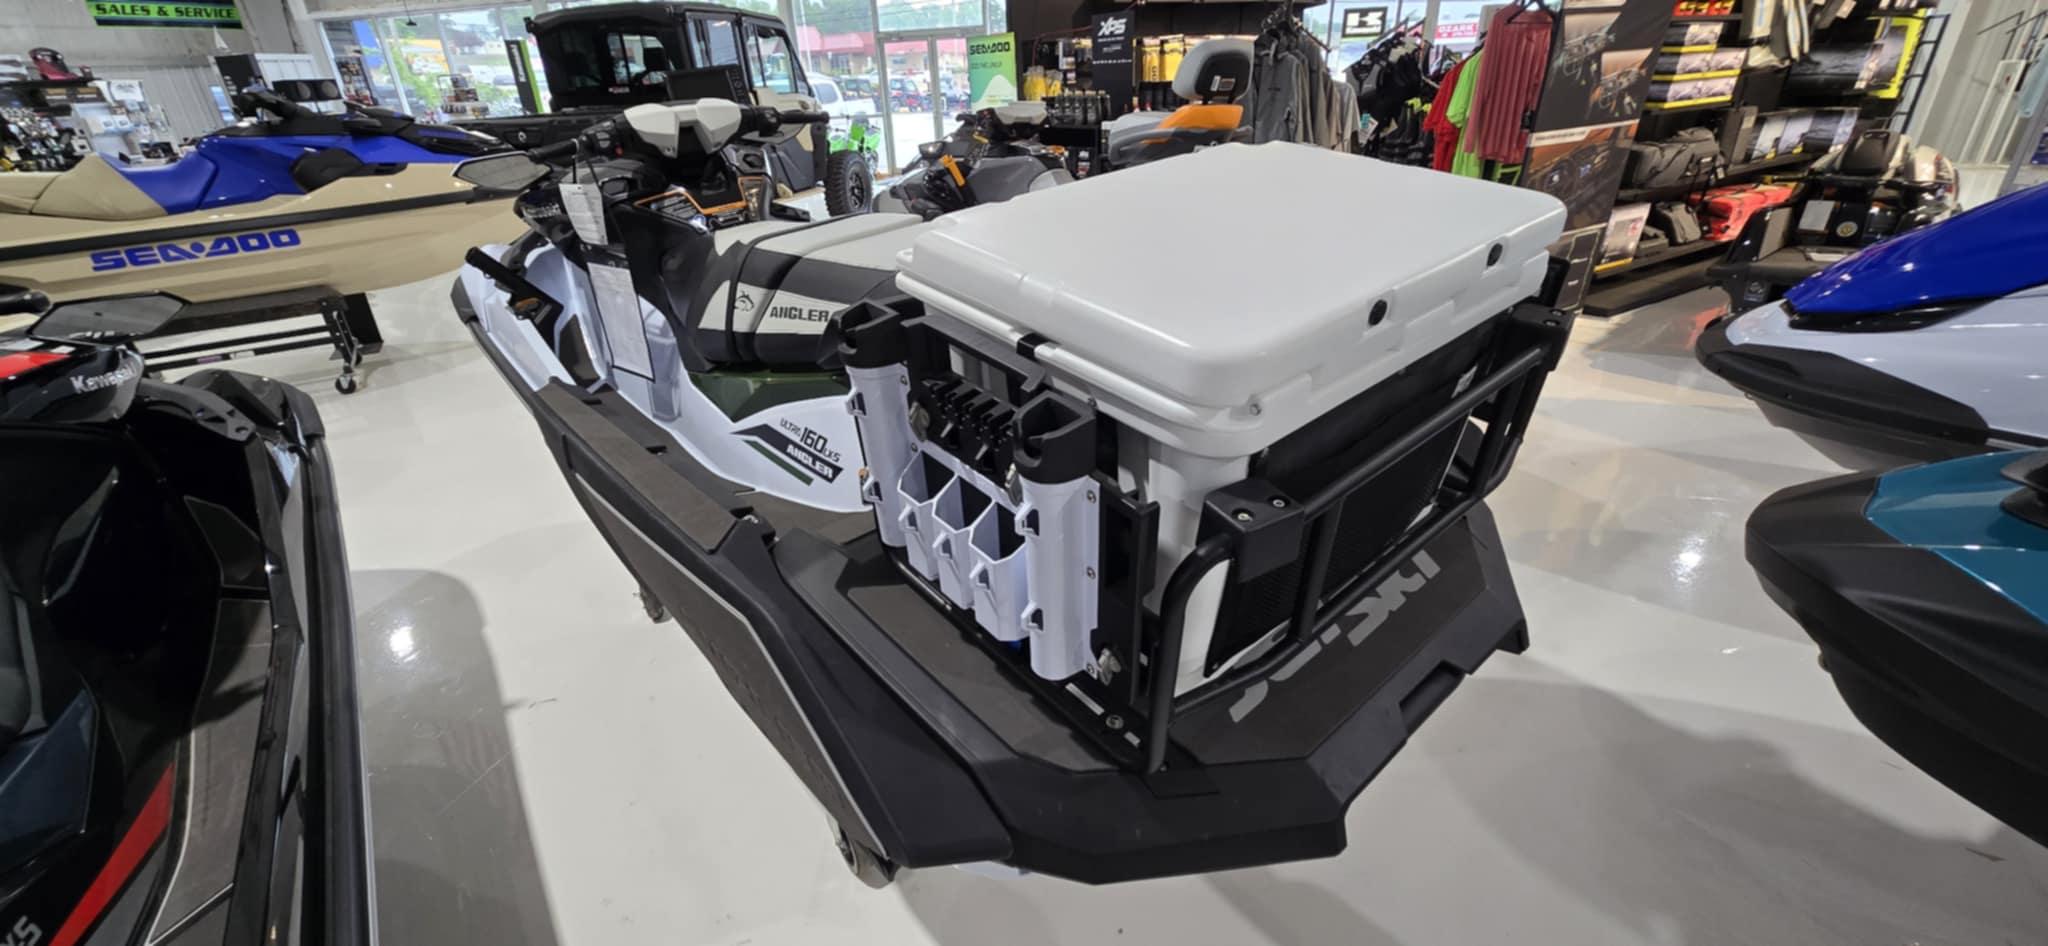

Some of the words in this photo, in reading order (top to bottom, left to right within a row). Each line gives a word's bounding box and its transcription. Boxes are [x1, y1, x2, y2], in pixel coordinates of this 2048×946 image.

[95, 3, 150, 16] SALES
[157, 5, 169, 16] &
[174, 6, 235, 18] SERVICE
[1097, 16, 1127, 36] XPS
[770, 306, 829, 322] ANGLER
[786, 444, 834, 479] ANGLER
